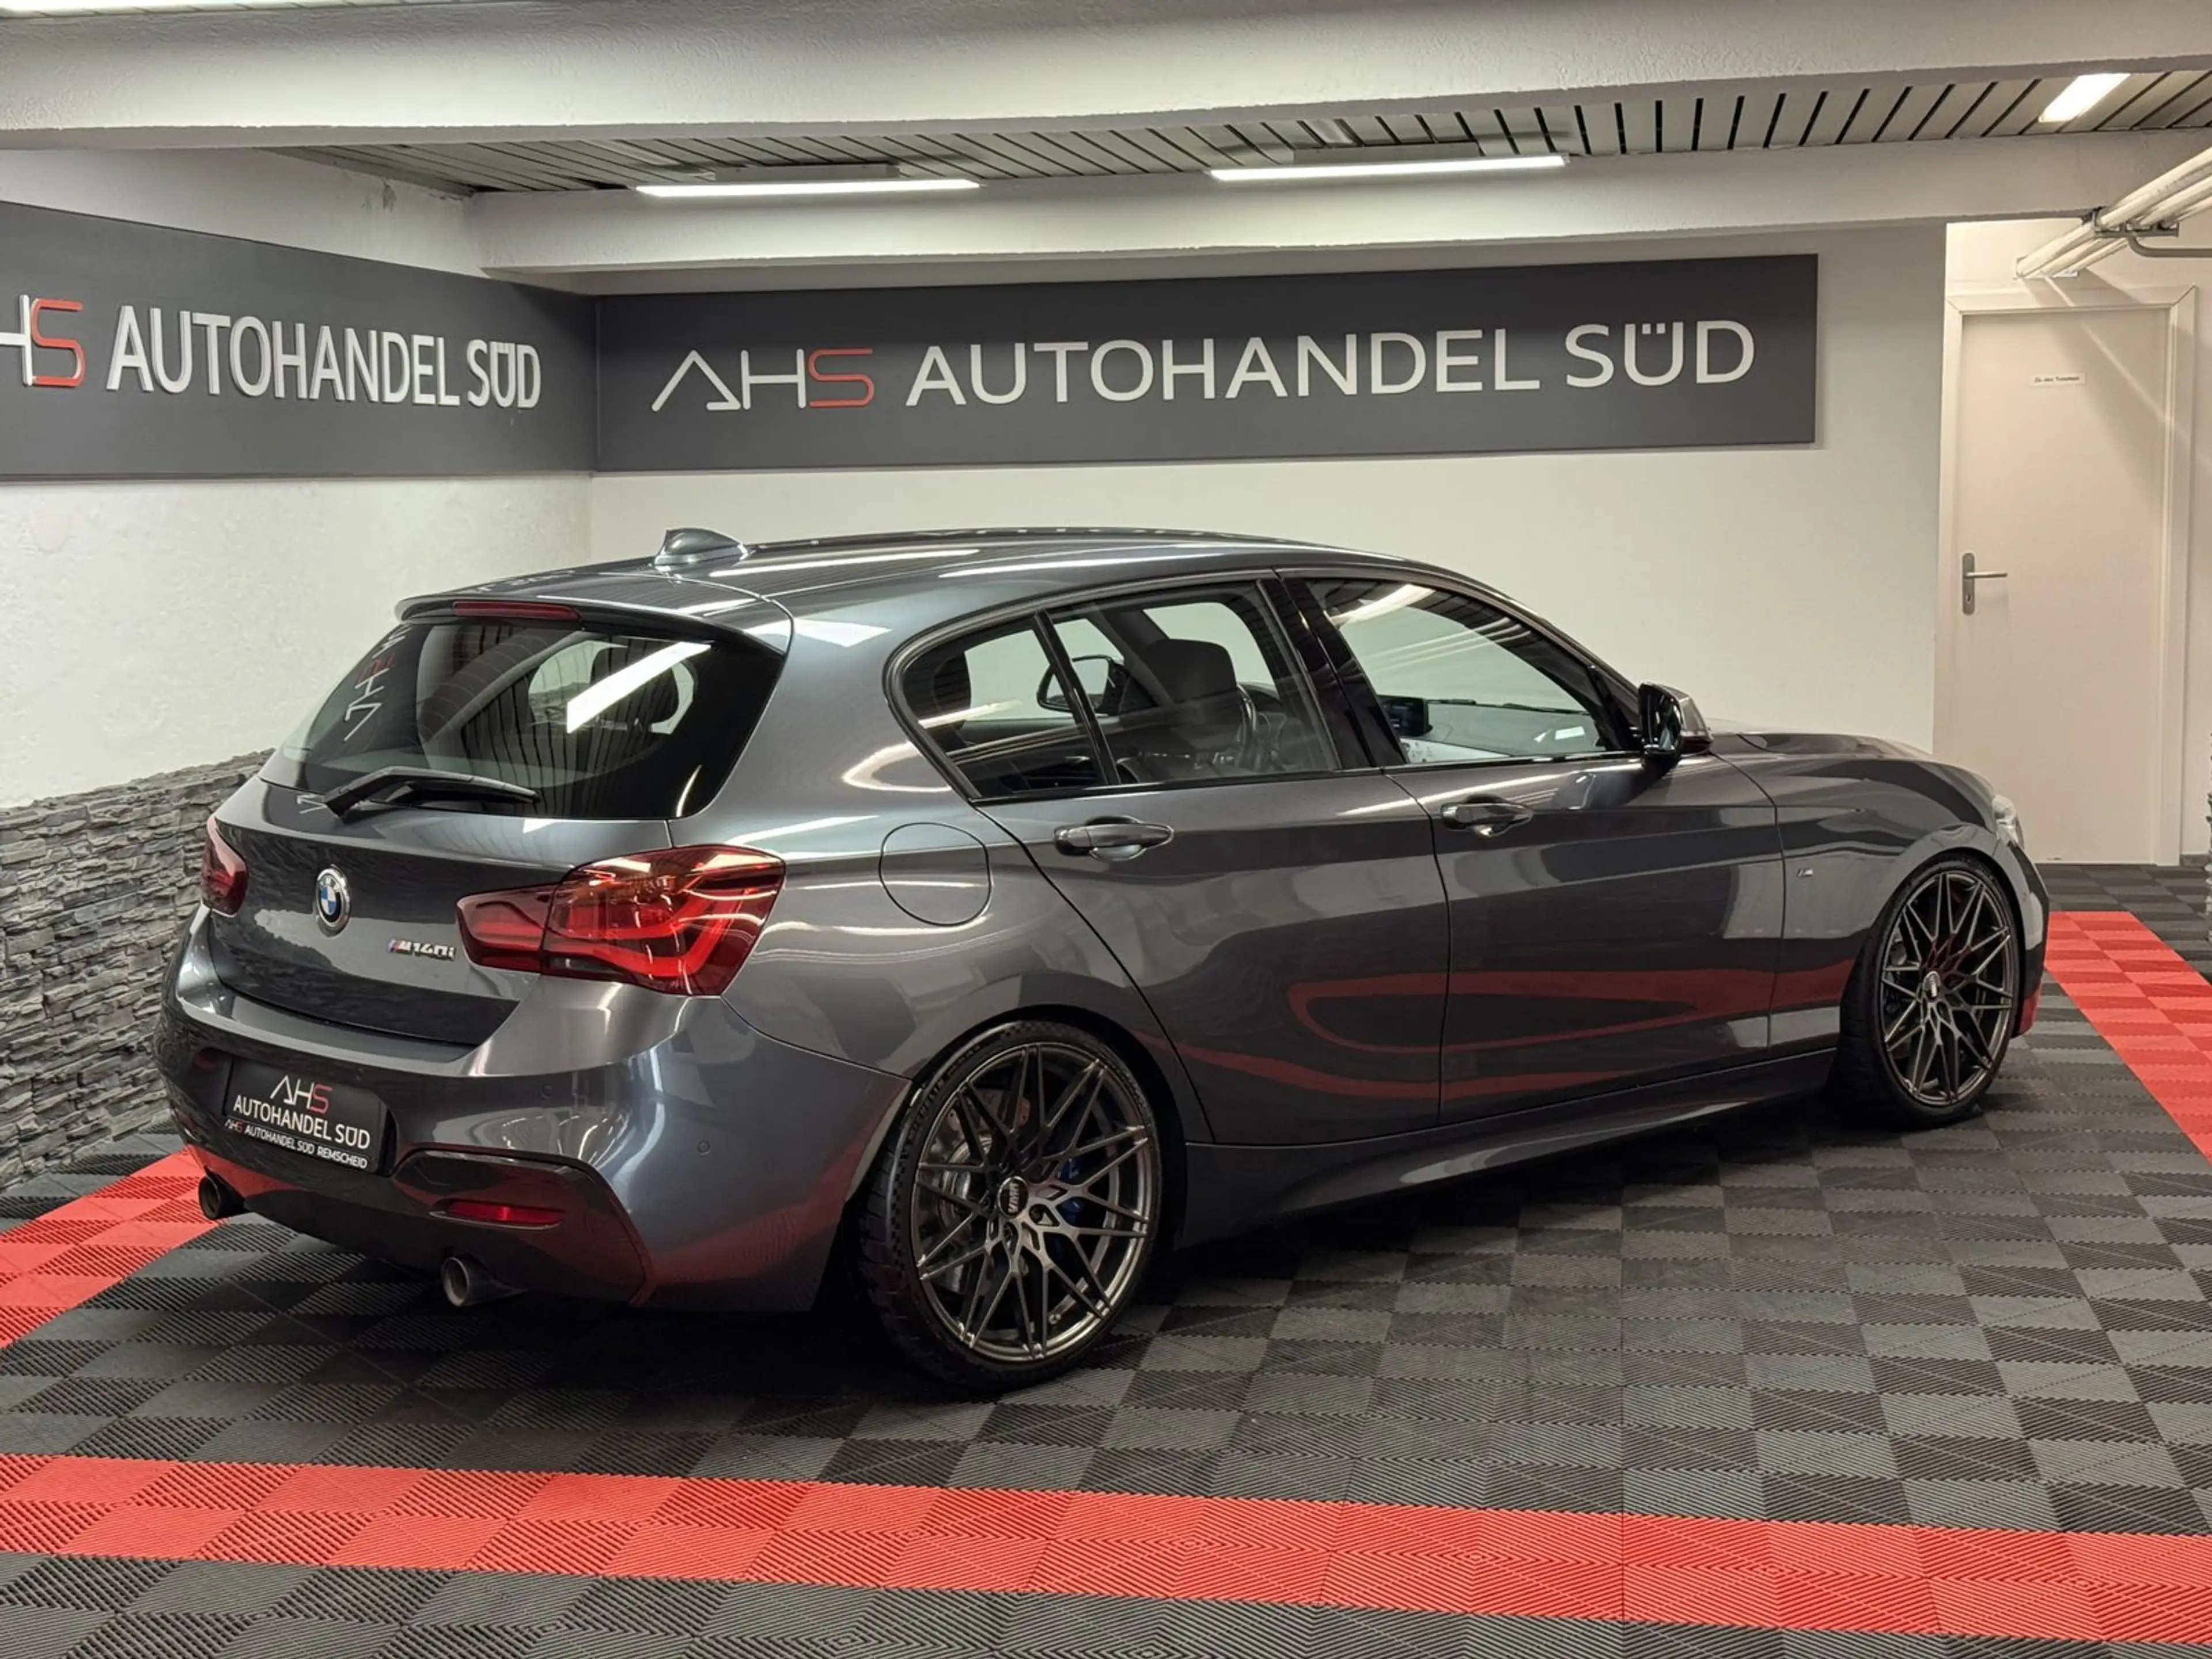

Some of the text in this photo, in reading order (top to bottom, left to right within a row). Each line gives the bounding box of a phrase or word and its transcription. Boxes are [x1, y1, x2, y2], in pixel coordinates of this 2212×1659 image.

[0, 294, 541, 408] HS AUTOHANDEL SÜD
[652, 321, 1755, 412] AHS AUTOHANDEL SÜD
[233, 1094, 370, 1150] AUTOHANDEL SÜD
[270, 1074, 333, 1114] AHS
[244, 1124, 297, 1150] AUTOHANDEL
[316, 1146, 368, 1170] REMSCHEID
